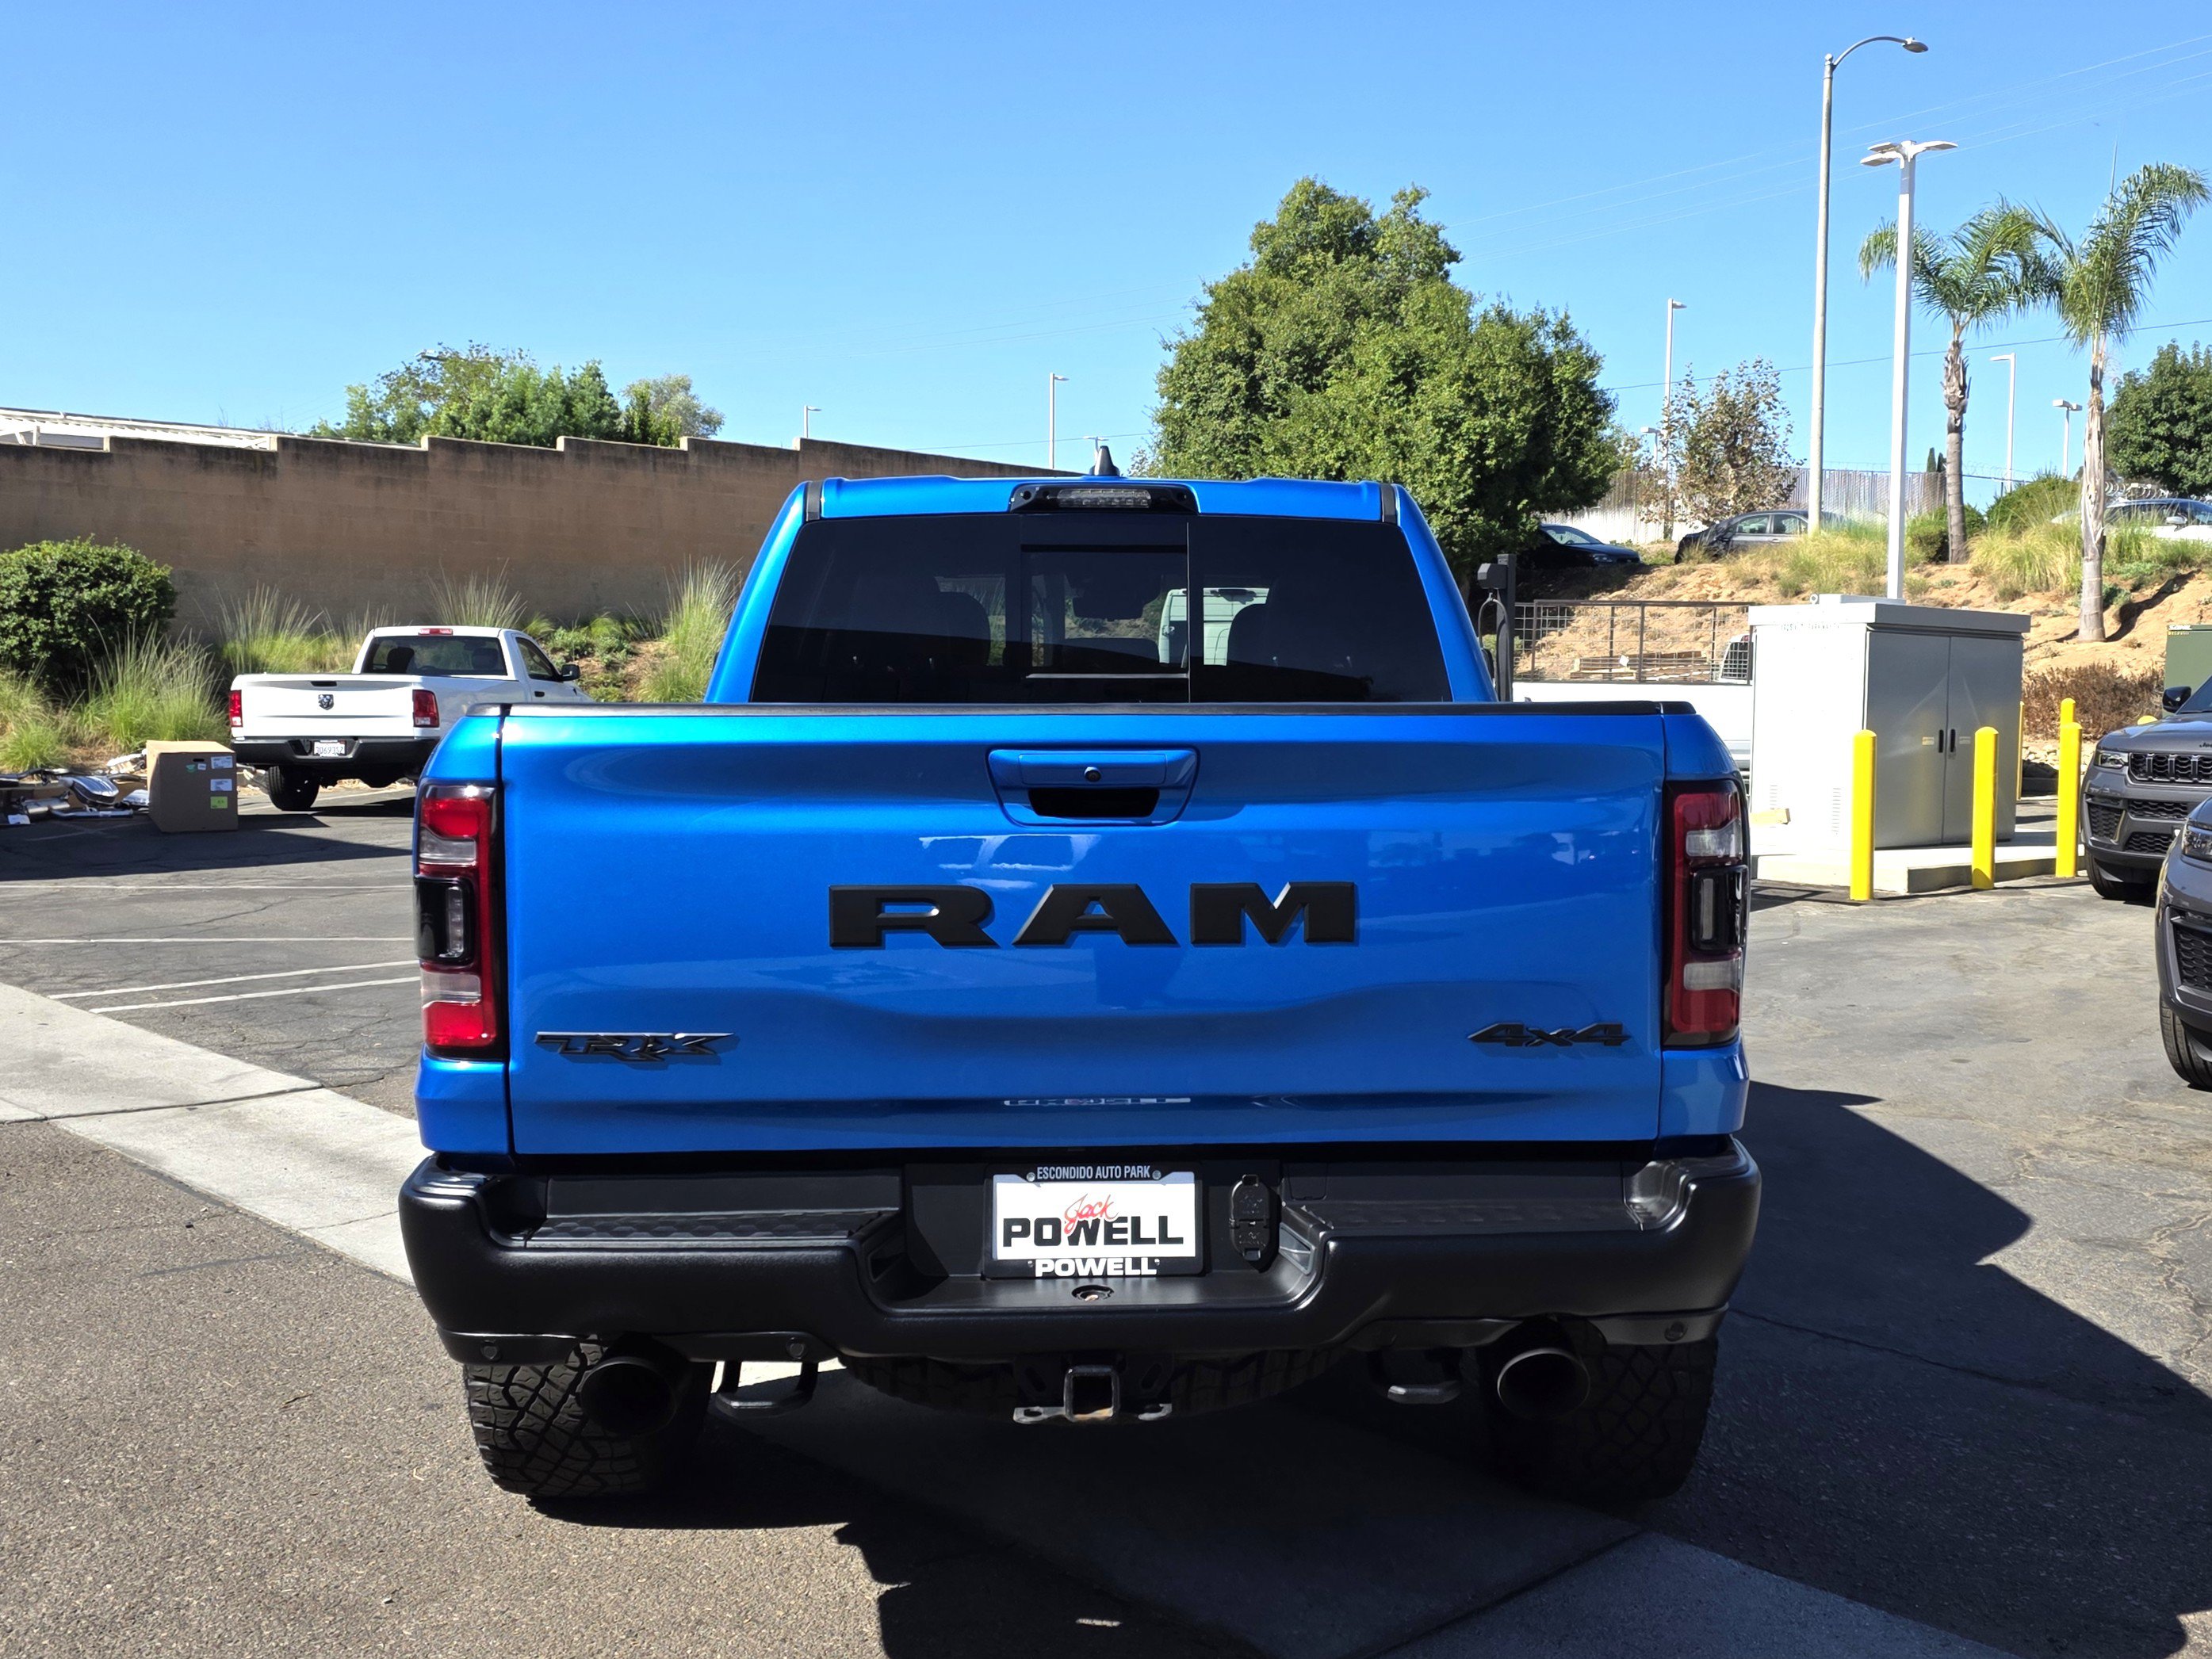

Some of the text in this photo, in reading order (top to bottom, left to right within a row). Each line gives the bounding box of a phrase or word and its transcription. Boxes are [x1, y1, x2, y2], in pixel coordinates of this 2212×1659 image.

[829, 881, 1356, 949] RAM
[534, 1031, 735, 1063] TRX
[1036, 1165, 1150, 1179] ESCONDIDO AUTO PARK
[1063, 1193, 1119, 1235] Jack
[1003, 1215, 1184, 1248] POWELL
[1035, 1257, 1158, 1278] POWELL
